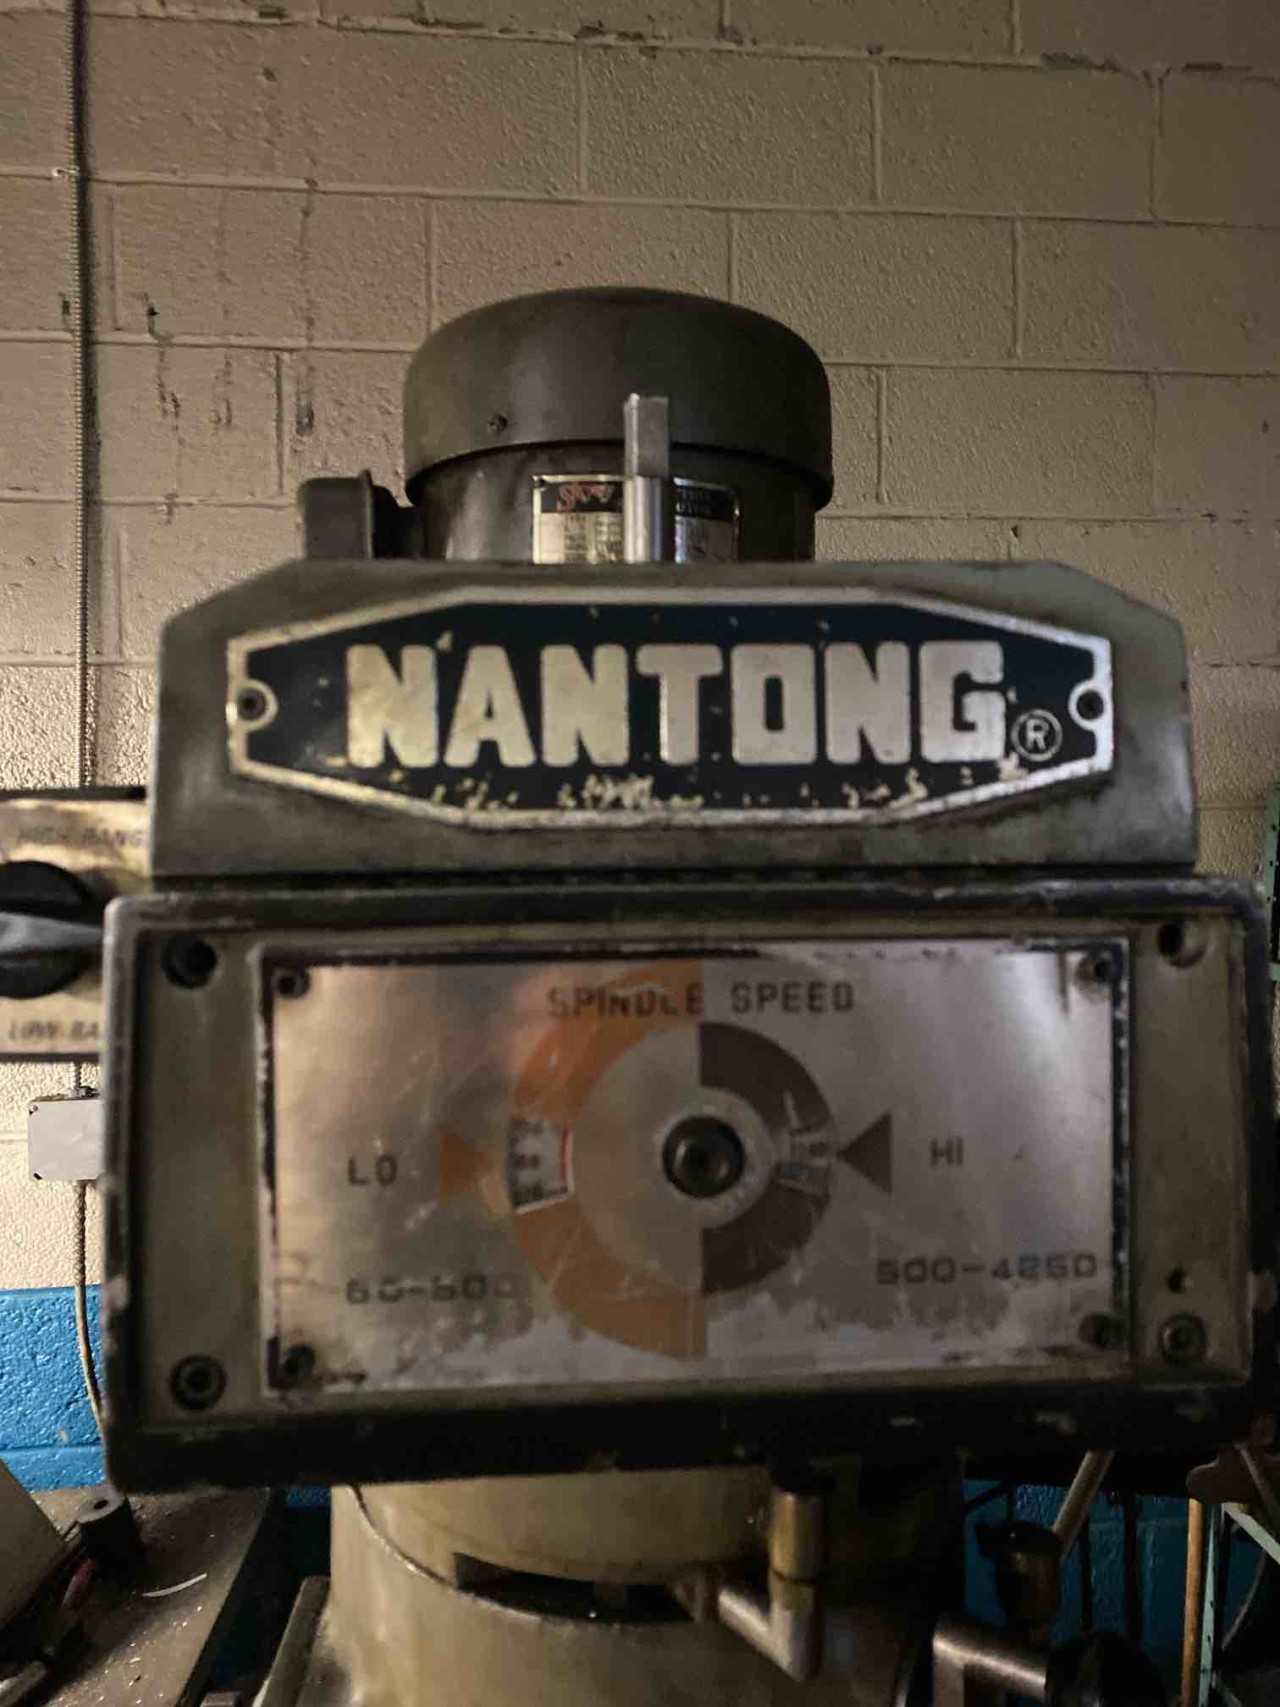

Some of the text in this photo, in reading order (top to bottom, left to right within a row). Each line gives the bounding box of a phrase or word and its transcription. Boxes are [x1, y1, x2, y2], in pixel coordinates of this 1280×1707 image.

[345, 640, 1005, 768] NANTONG
[547, 981, 855, 1018] SPINDLE SPEED
[930, 1137, 964, 1167] HI
[348, 1154, 397, 1187] LO
